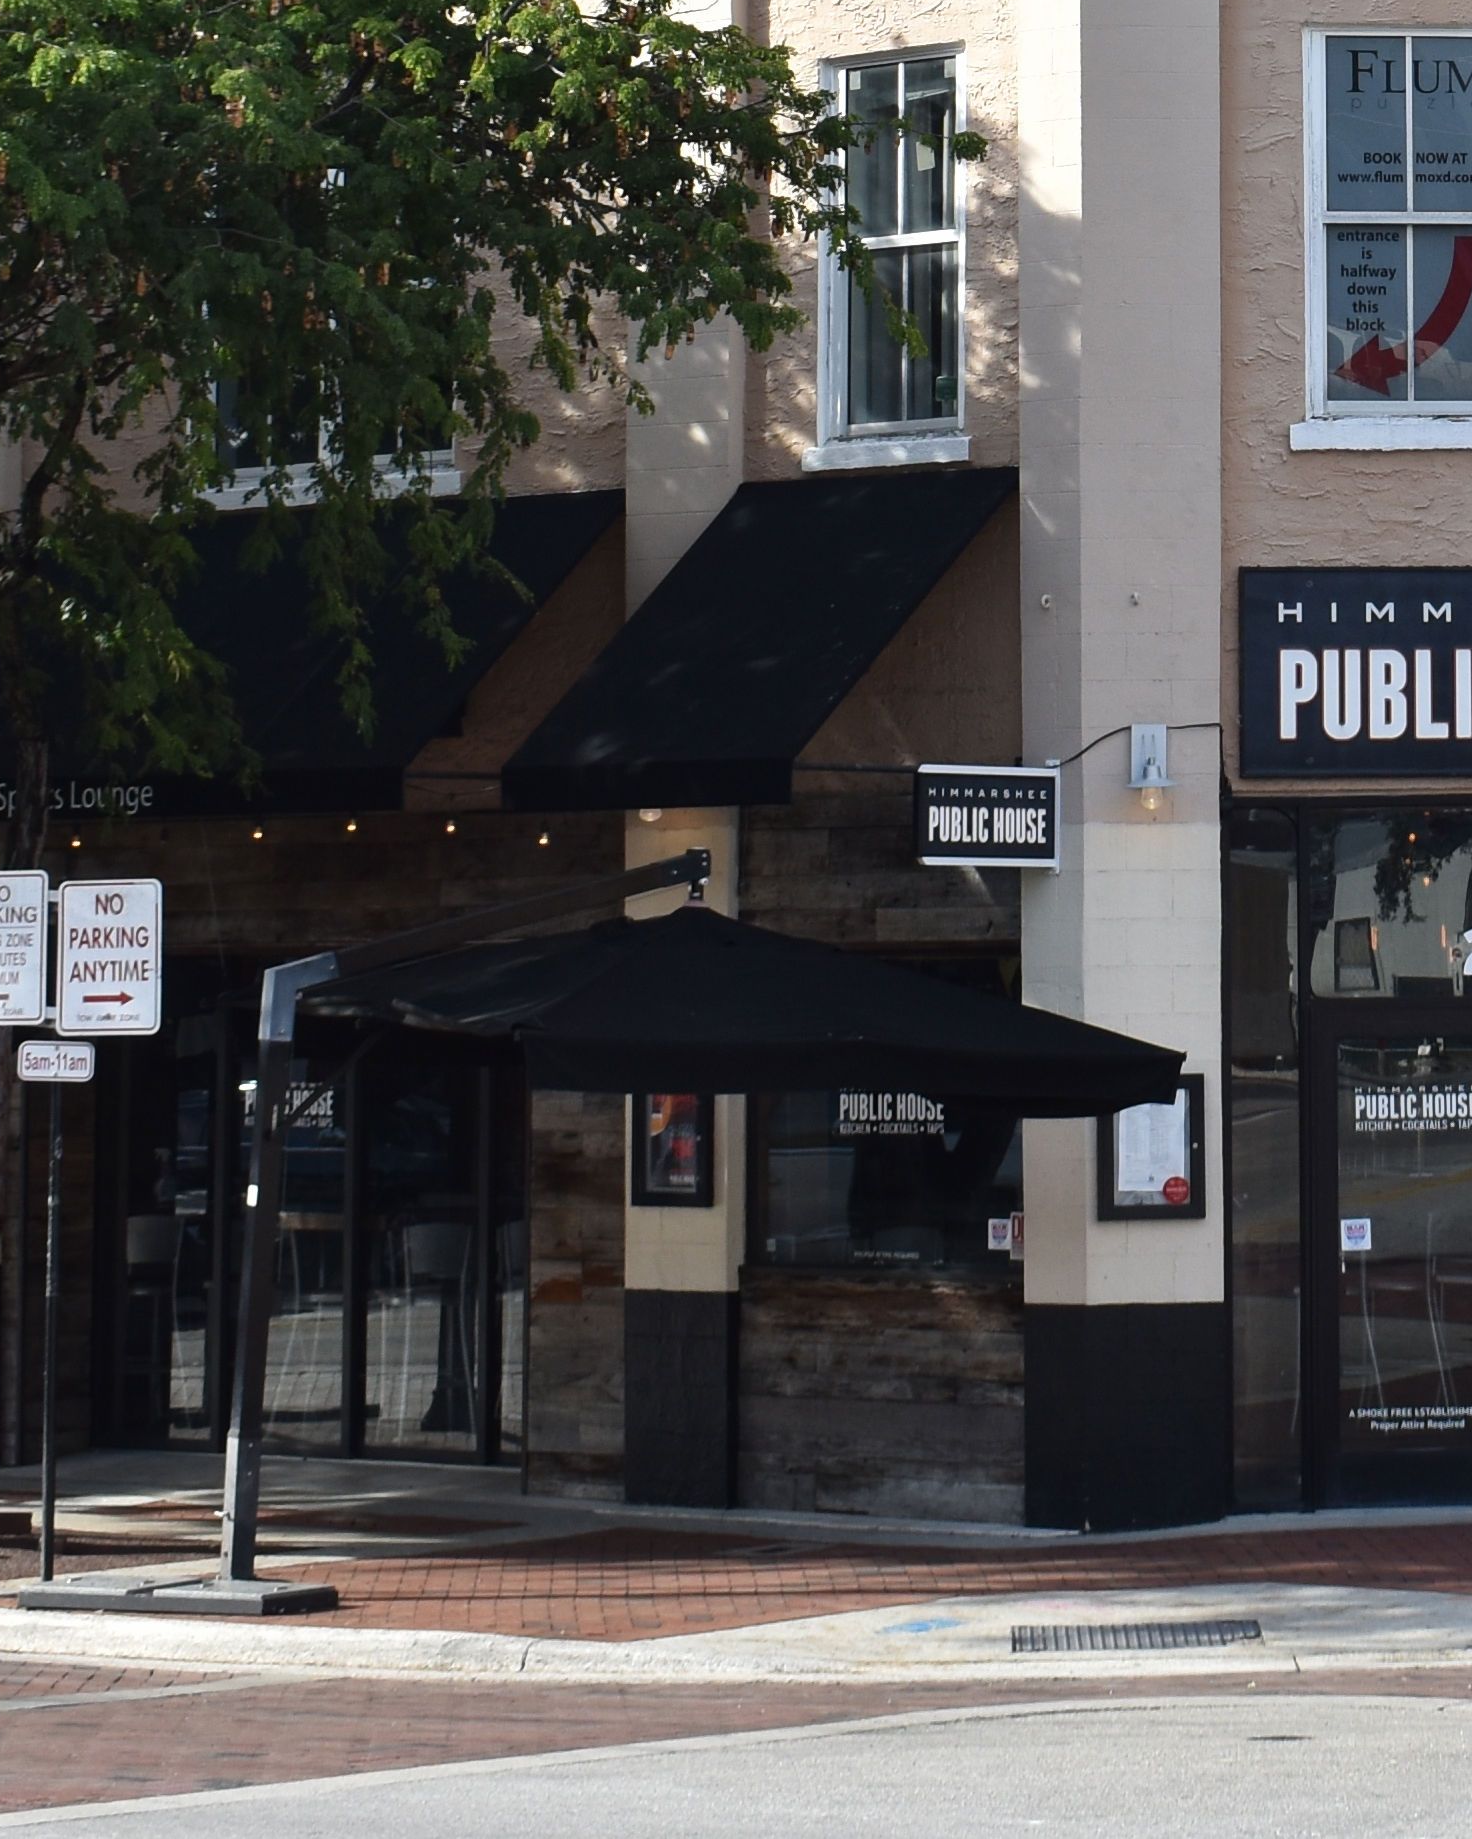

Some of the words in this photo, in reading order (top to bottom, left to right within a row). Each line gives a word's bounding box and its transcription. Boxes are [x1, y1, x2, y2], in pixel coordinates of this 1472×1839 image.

[1364, 152, 1402, 165] BOOK
[1415, 152, 1448, 165] NOW
[1451, 152, 1468, 165] AT
[1337, 229, 1400, 242] entrance
[1361, 246, 1373, 259] is
[1340, 264, 1397, 280] halfway
[1347, 282, 1387, 296] down
[1352, 300, 1379, 313] this
[1346, 318, 1385, 331] block
[928, 787, 1047, 800] HIMMARSHEE
[928, 805, 989, 843] PUBLIC
[993, 807, 1047, 844] HOUSE
[94, 893, 125, 916] NO
[5, 932, 35, 948] ZONE
[69, 926, 149, 950] PARKING
[69, 960, 150, 983] ANYTIME
[24, 1052, 88, 1071] 5am-11am
[839, 1092, 893, 1121] PUBLIC
[1355, 1093, 1417, 1119] PUBLIC
[1355, 1120, 1392, 1131] KITCHEN
[1402, 1119, 1448, 1131] COCKTAILS
[1390, 1407, 1413, 1418] FREE
